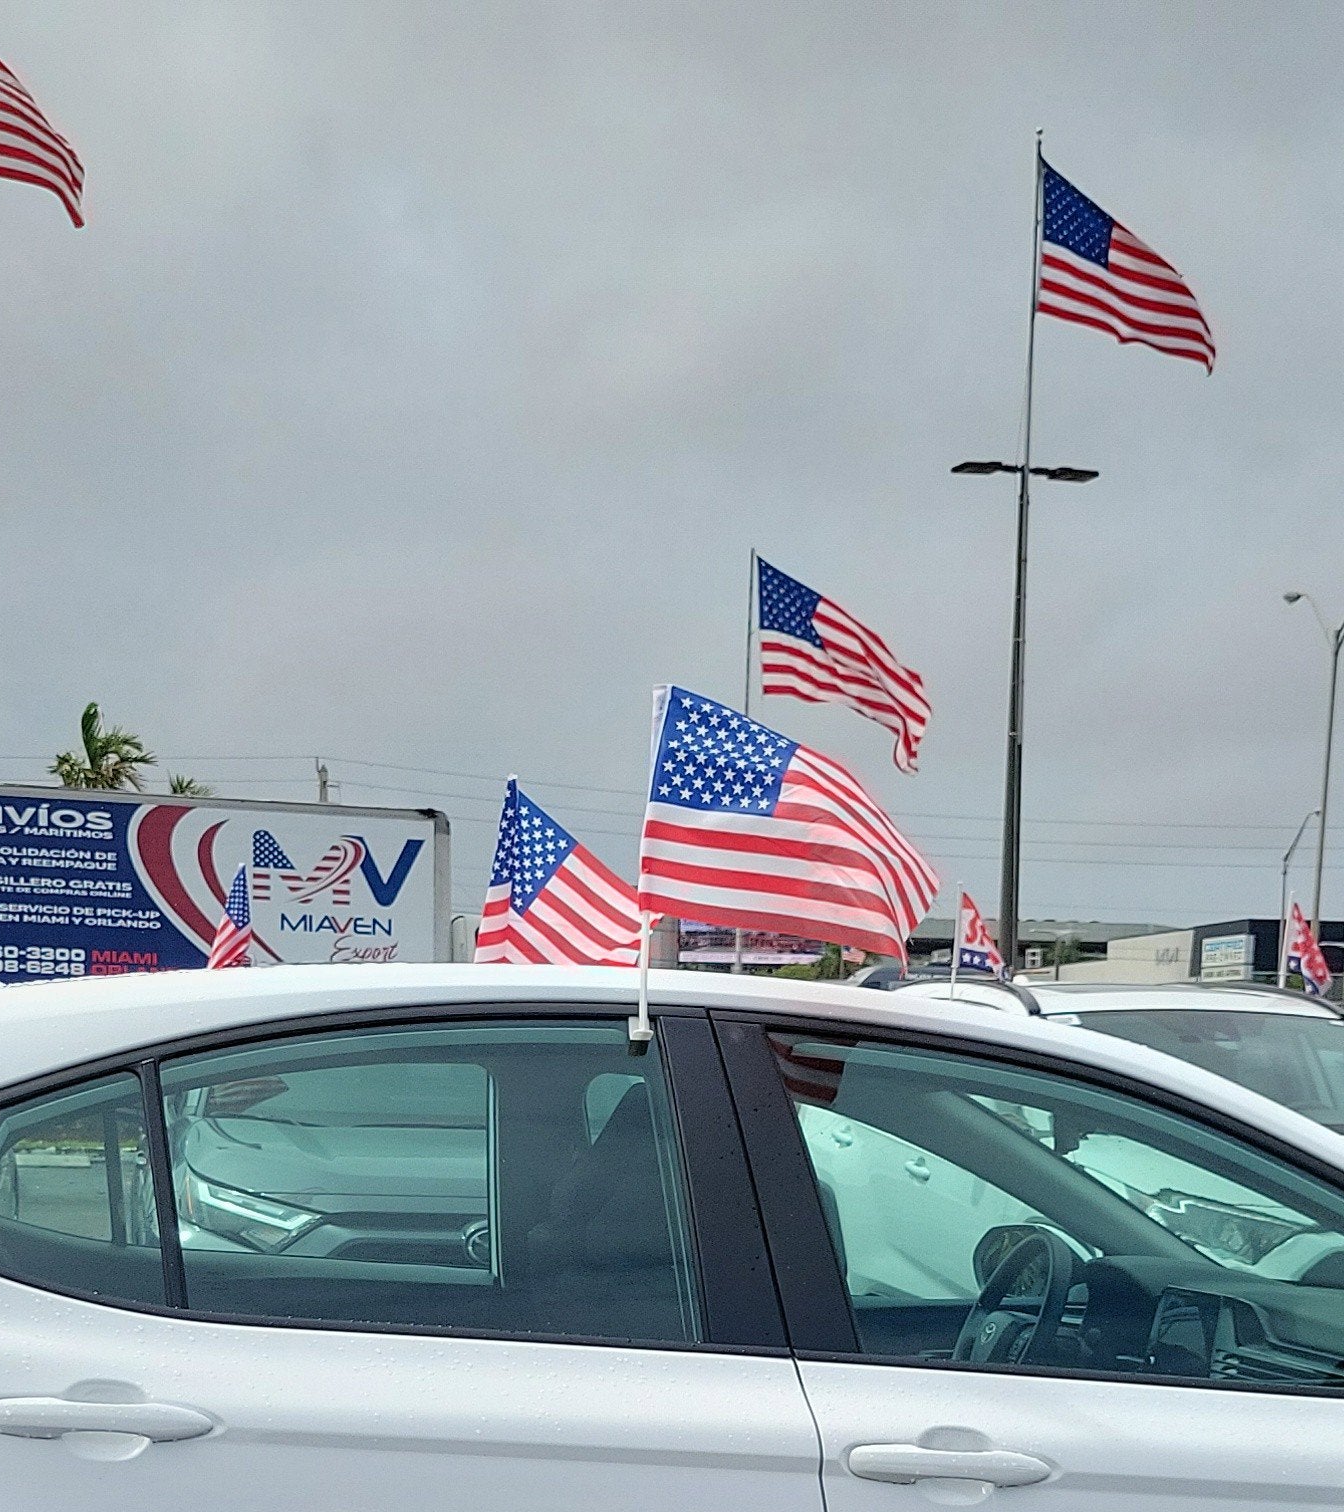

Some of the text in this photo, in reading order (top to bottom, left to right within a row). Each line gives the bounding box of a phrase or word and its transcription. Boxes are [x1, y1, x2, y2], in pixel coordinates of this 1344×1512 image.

[94, 851, 118, 862] DE
[8, 857, 20, 866] Y
[21, 858, 118, 871] REEMPAQUE
[15, 886, 32, 894] DE
[33, 887, 88, 897] COMPRAS
[89, 890, 133, 899] ONLINE
[69, 880, 133, 892] GRATIS
[72, 907, 94, 917] DE
[96, 908, 161, 920] PICK-UP
[22, 914, 69, 925] MIAMI
[71, 916, 84, 925] Y
[84, 917, 162, 930] ORLANDO
[280, 913, 392, 936] MIAVEN
[91, 950, 159, 965] MIAMI
